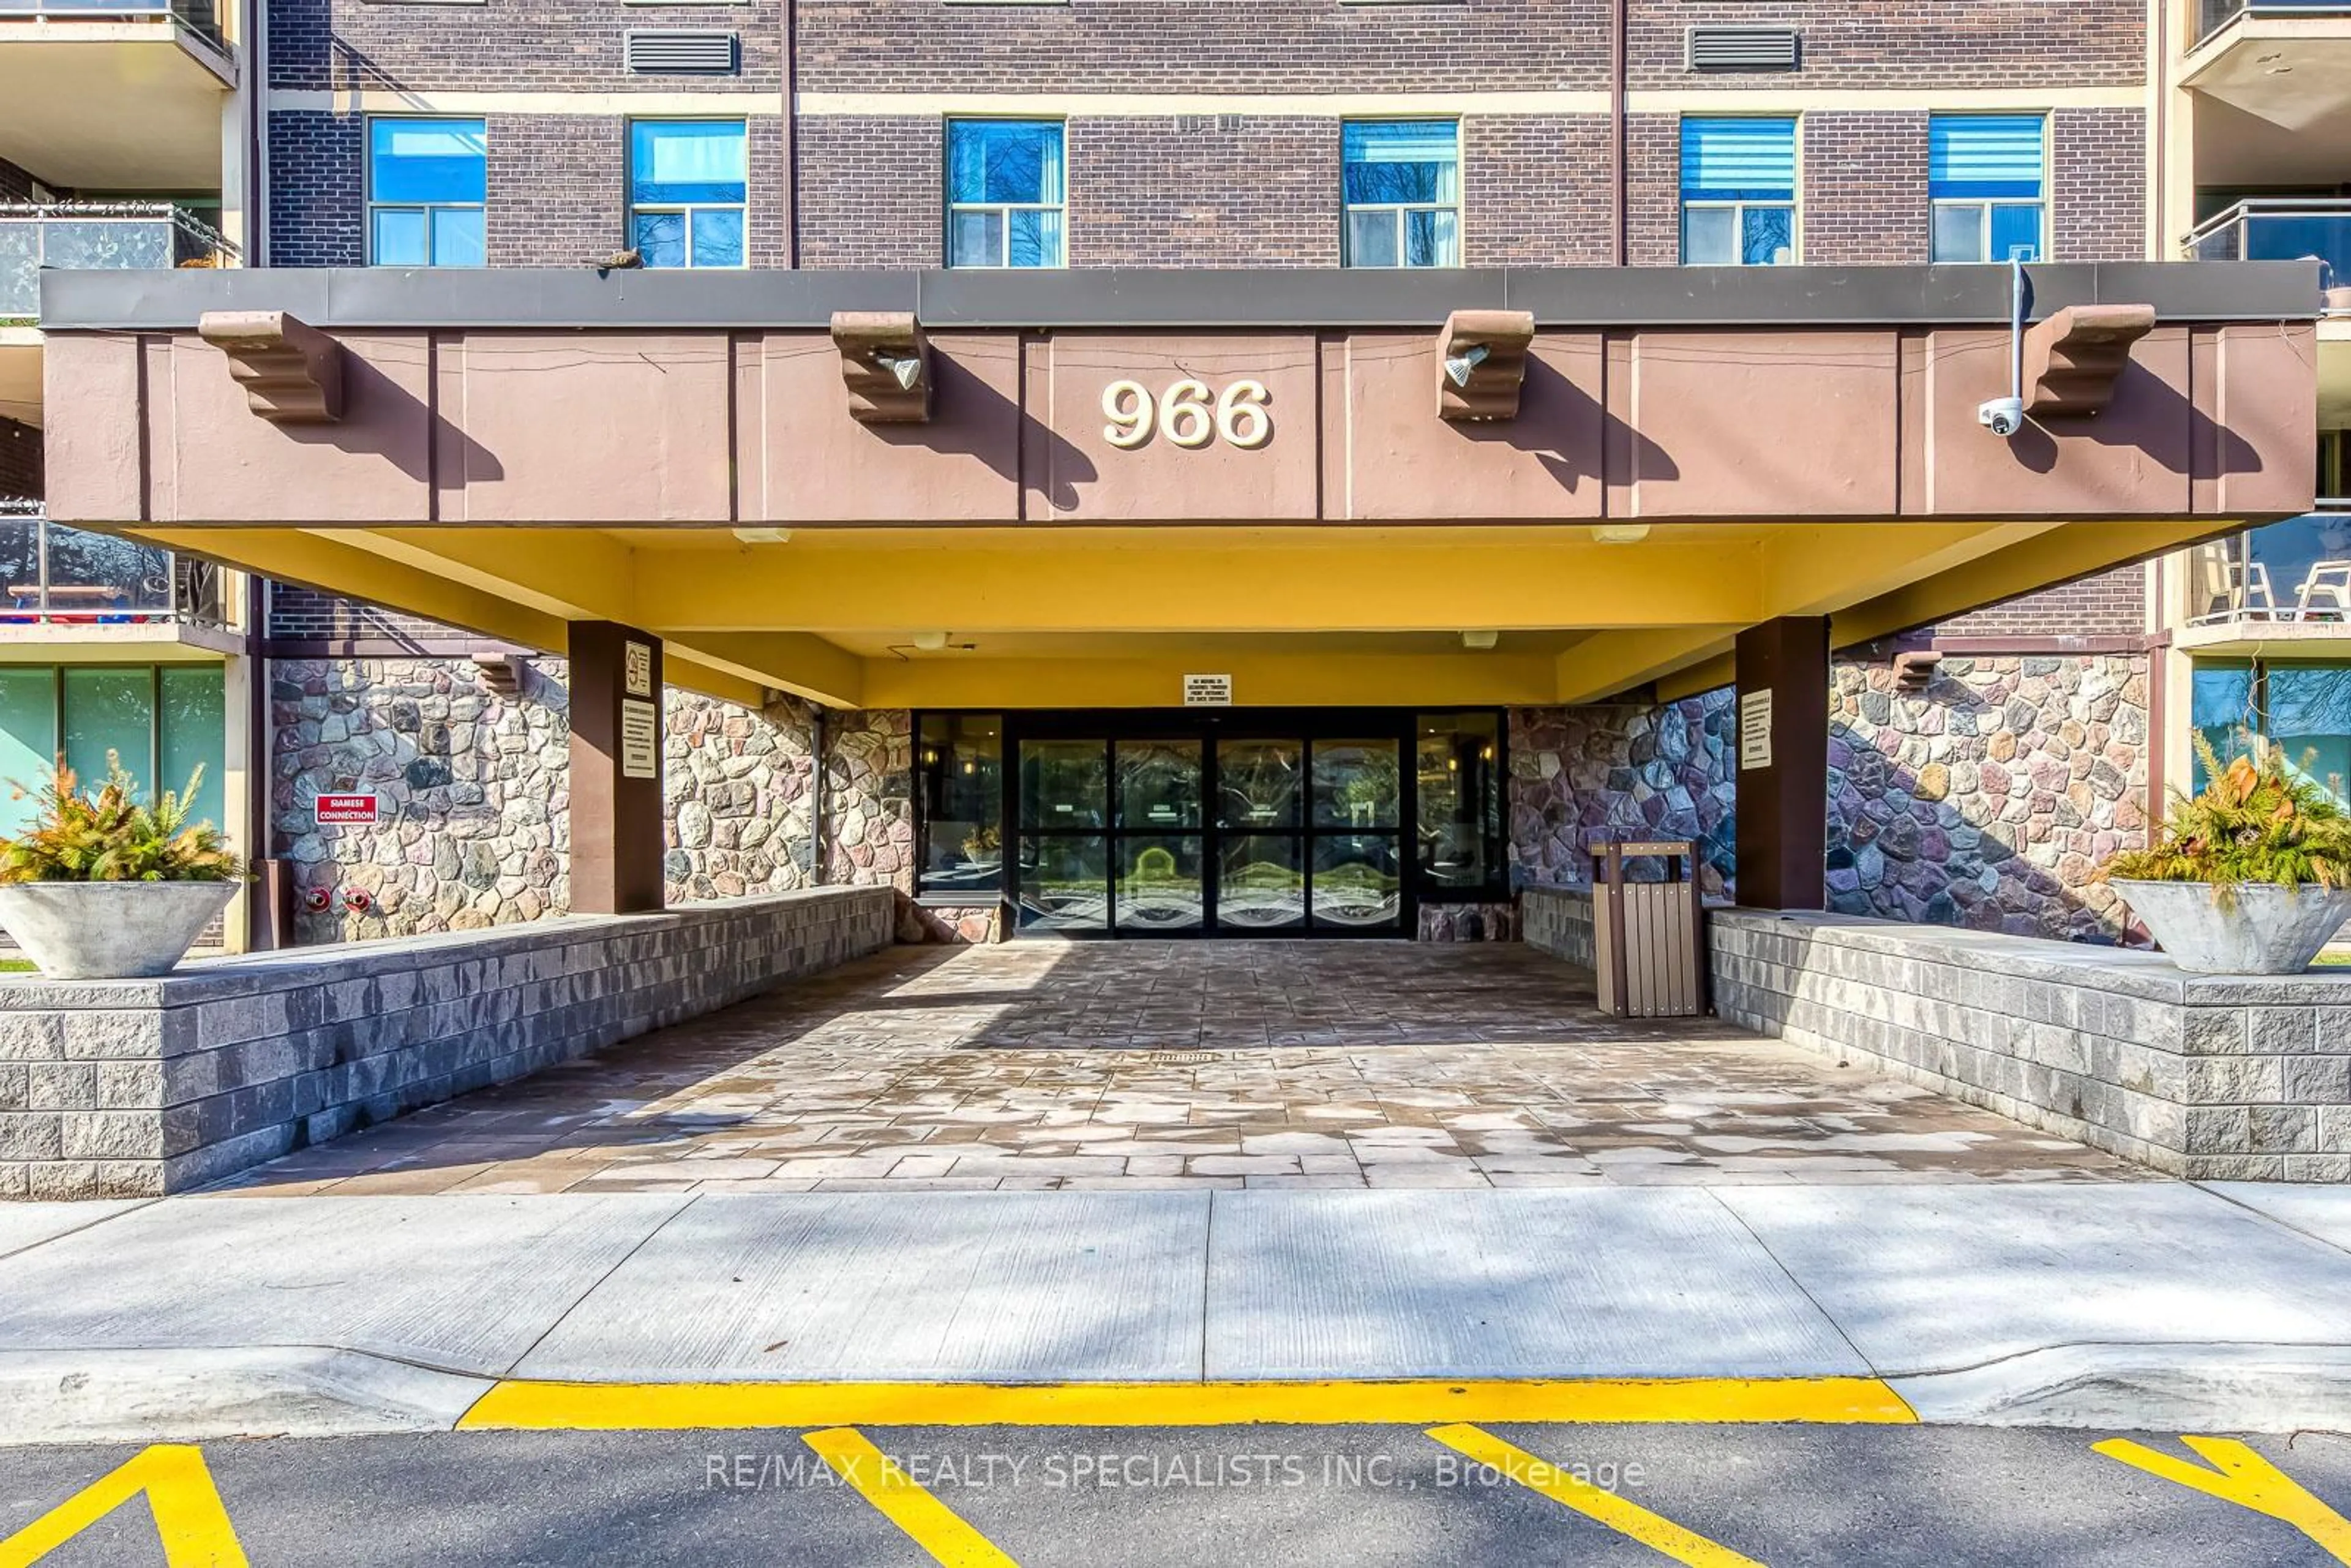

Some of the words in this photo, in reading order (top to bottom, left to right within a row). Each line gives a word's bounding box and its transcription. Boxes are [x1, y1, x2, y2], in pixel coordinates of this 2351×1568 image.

[1101, 379, 1270, 447] 966
[330, 799, 365, 808] SIAMESE
[320, 811, 374, 820] CONNECTION
